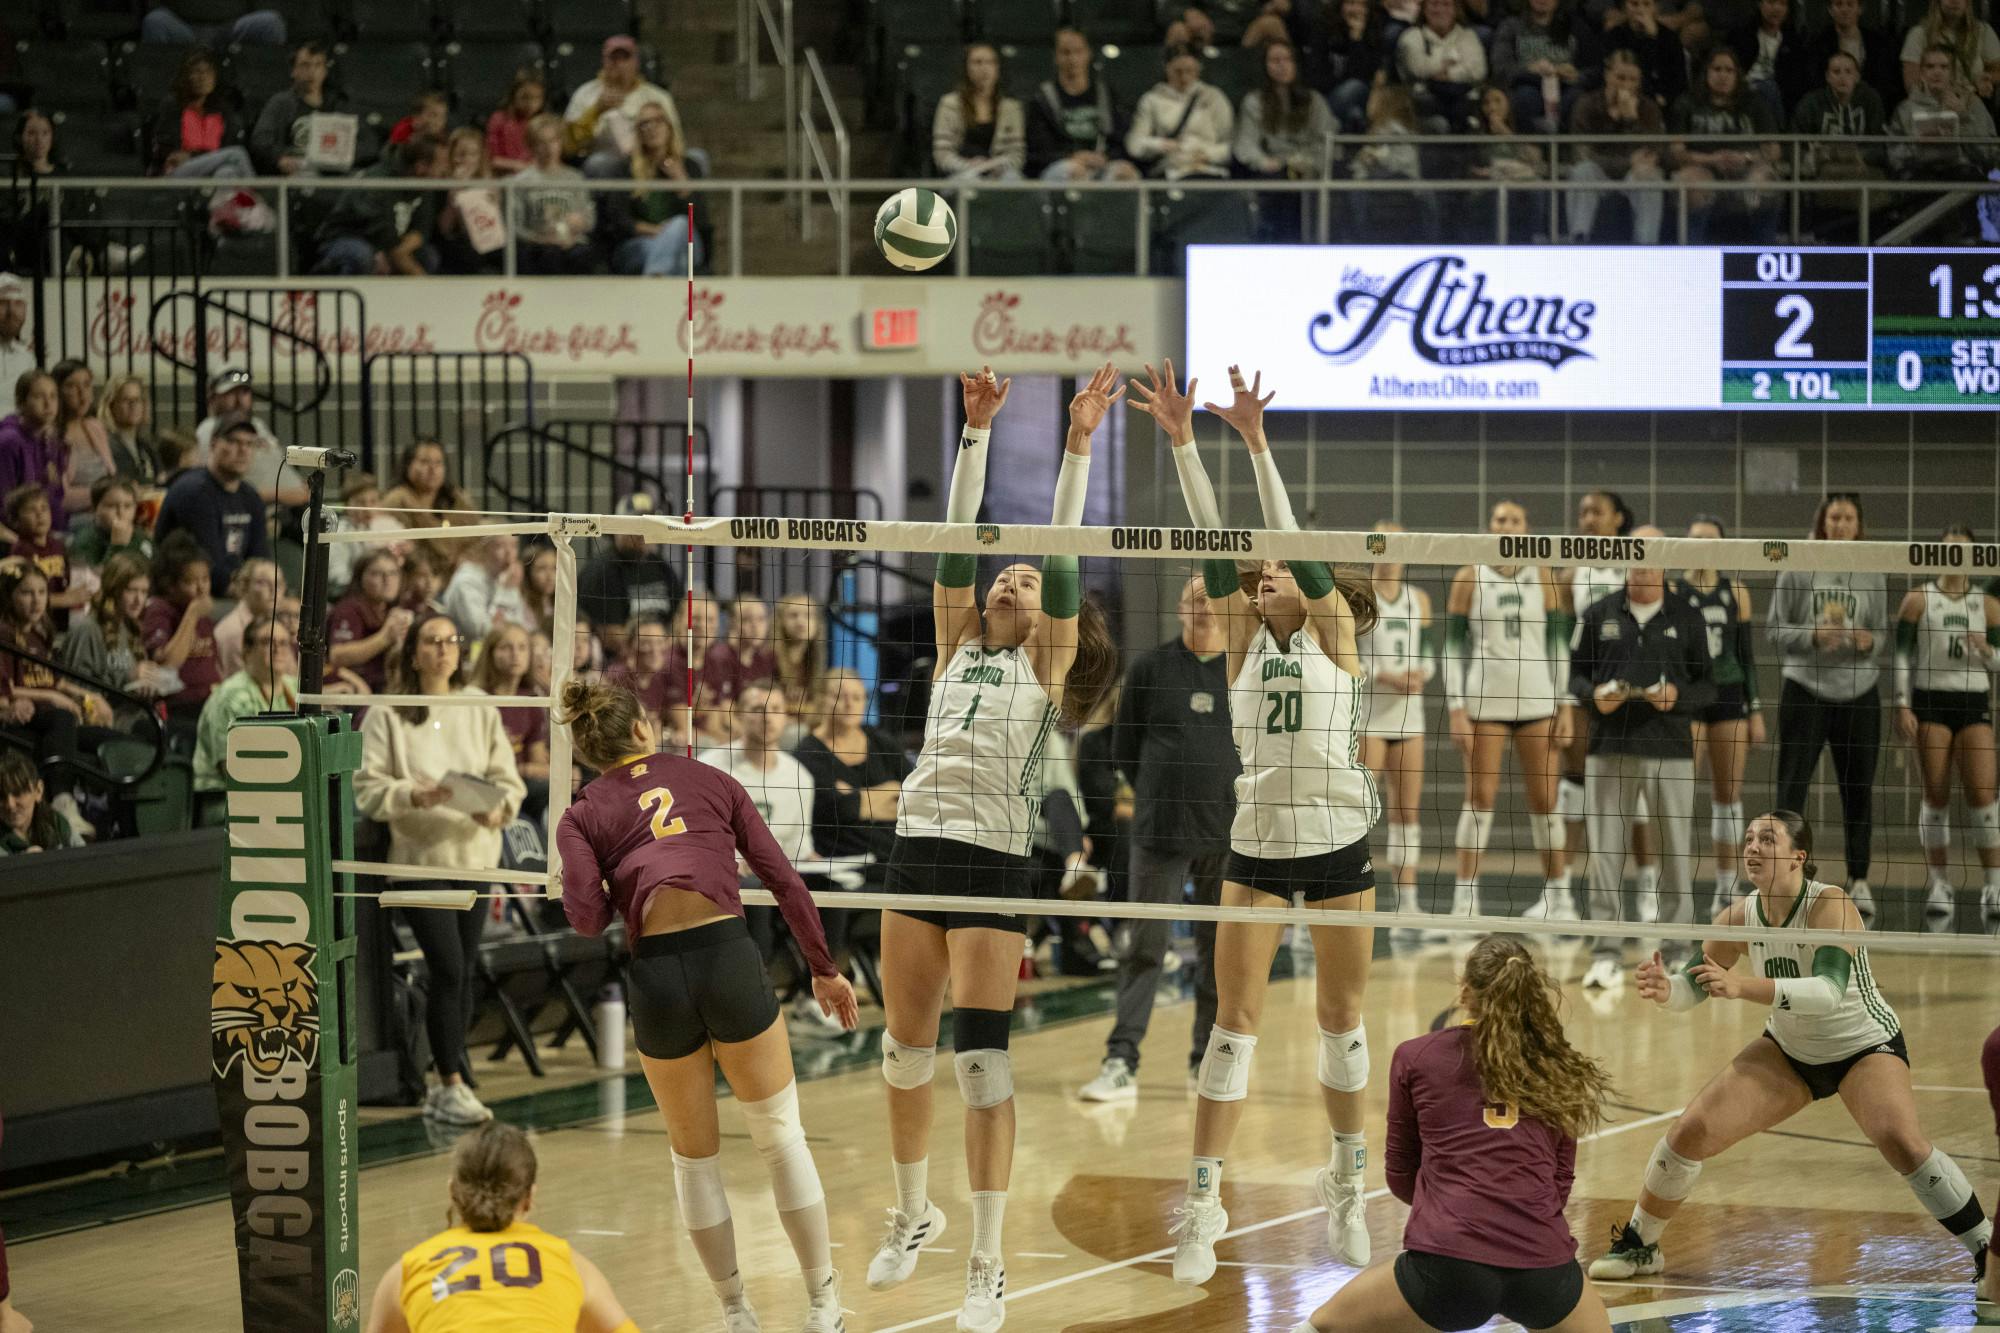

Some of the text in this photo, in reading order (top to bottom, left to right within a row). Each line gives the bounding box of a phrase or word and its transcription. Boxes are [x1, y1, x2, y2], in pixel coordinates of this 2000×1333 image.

[1757, 253, 1801, 282] OU
[1308, 256, 1597, 362] Athens
[874, 309, 919, 347] EXIT
[1774, 294, 1814, 358] 2
[1370, 374, 1539, 399] AthensOhio.com
[1752, 372, 1840, 400] 2 TOL
[1897, 350, 1922, 391] 0
[731, 519, 867, 543] OHIO BOBCATS
[1111, 528, 1253, 552] OHIO BOBCATS
[1500, 536, 1645, 561] OHIO BOBCATS
[1909, 543, 1963, 567] OHIO
[961, 665, 1004, 687] OHIO
[1262, 657, 1302, 682] OHIO
[961, 694, 982, 731] 1
[1267, 691, 1302, 734] 20
[638, 787, 688, 840] 2
[226, 726, 310, 945] OHIO
[1765, 957, 1800, 978] OHIO
[338, 1099, 349, 1253] sports imports
[430, 1242, 543, 1303] 20
